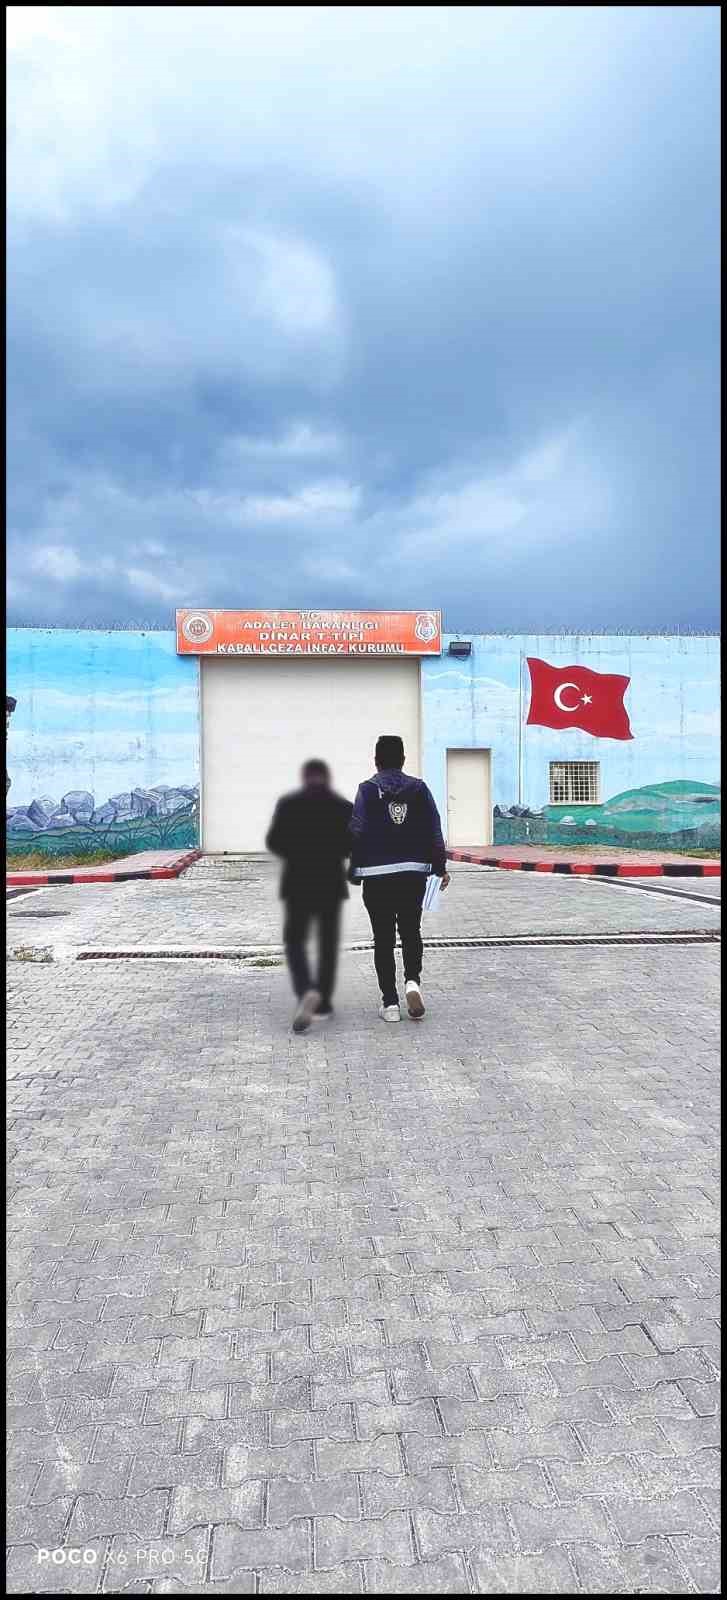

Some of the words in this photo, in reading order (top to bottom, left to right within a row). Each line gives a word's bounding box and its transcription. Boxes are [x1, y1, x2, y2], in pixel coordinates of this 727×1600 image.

[243, 620, 297, 629] ADALET
[259, 630, 311, 640] DİNAR
[217, 642, 265, 653] KAPALI
[268, 642, 303, 653] CEZA
[348, 642, 405, 653] KURUMU
